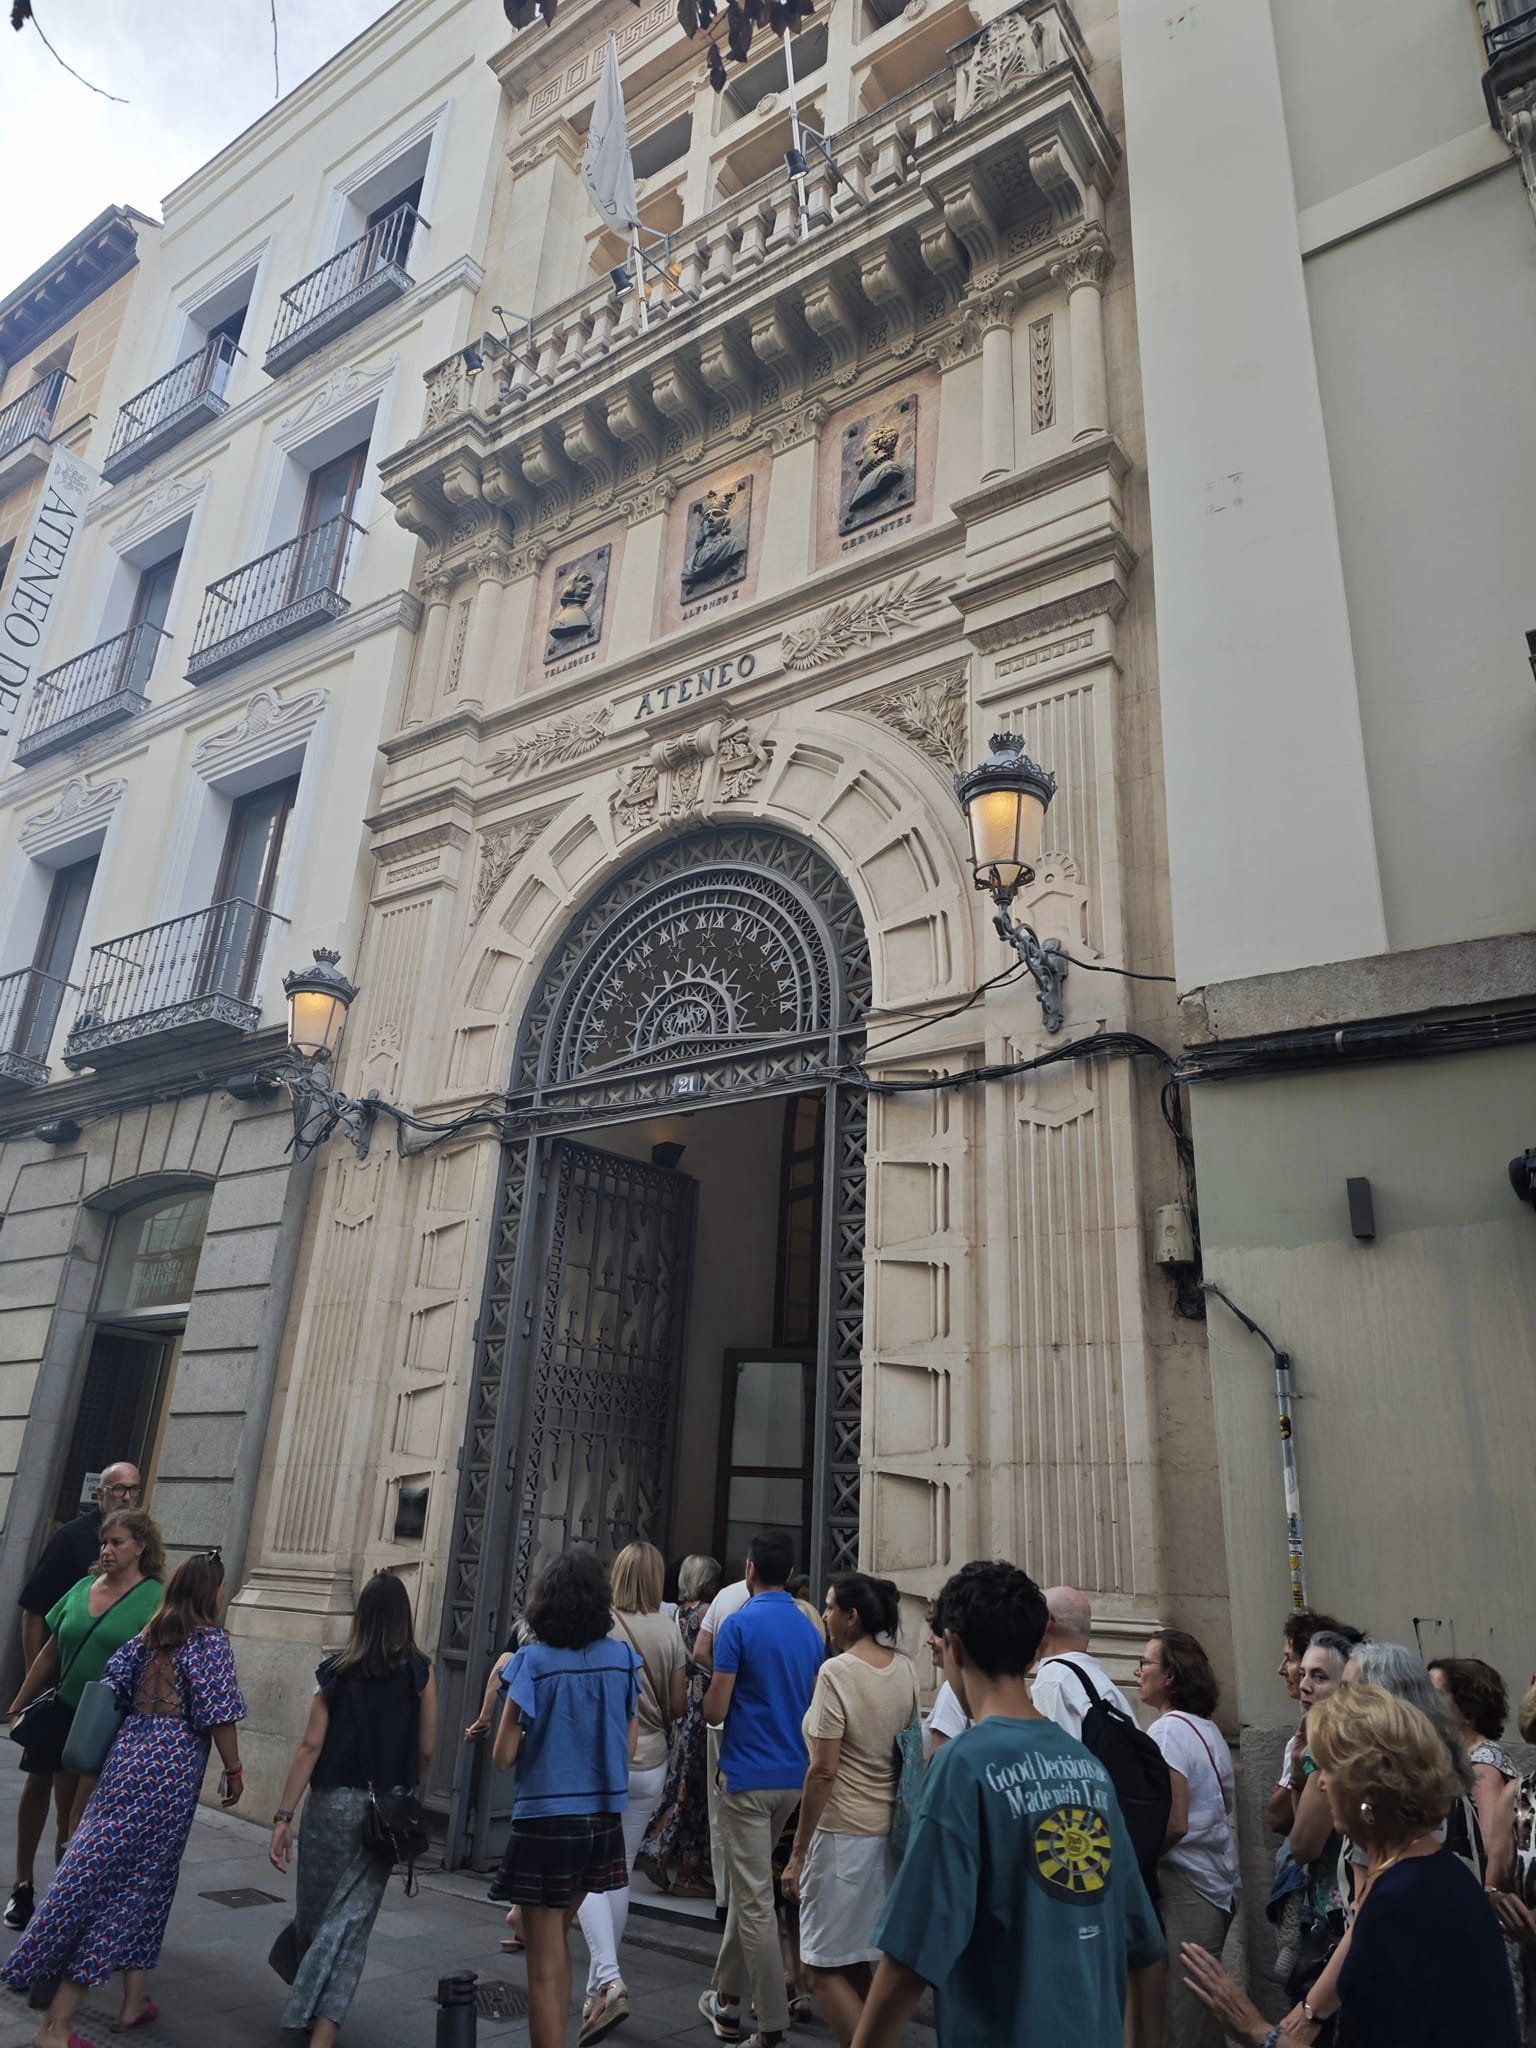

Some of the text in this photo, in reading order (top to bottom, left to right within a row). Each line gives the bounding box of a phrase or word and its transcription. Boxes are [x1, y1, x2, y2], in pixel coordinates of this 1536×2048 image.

[842, 514, 912, 551] CERVANTES
[4, 485, 78, 648] ATENEO
[682, 589, 739, 621] ALFONSO X
[544, 651, 597, 679] VELAZQUEZ
[633, 653, 756, 720] ATENEO
[678, 1075, 695, 1093] 21
[985, 1752, 1038, 1792] Good
[1034, 1751, 1096, 1780] Decisions
[1004, 1781, 1052, 1819] Made
[1051, 1780, 1081, 1805] with
